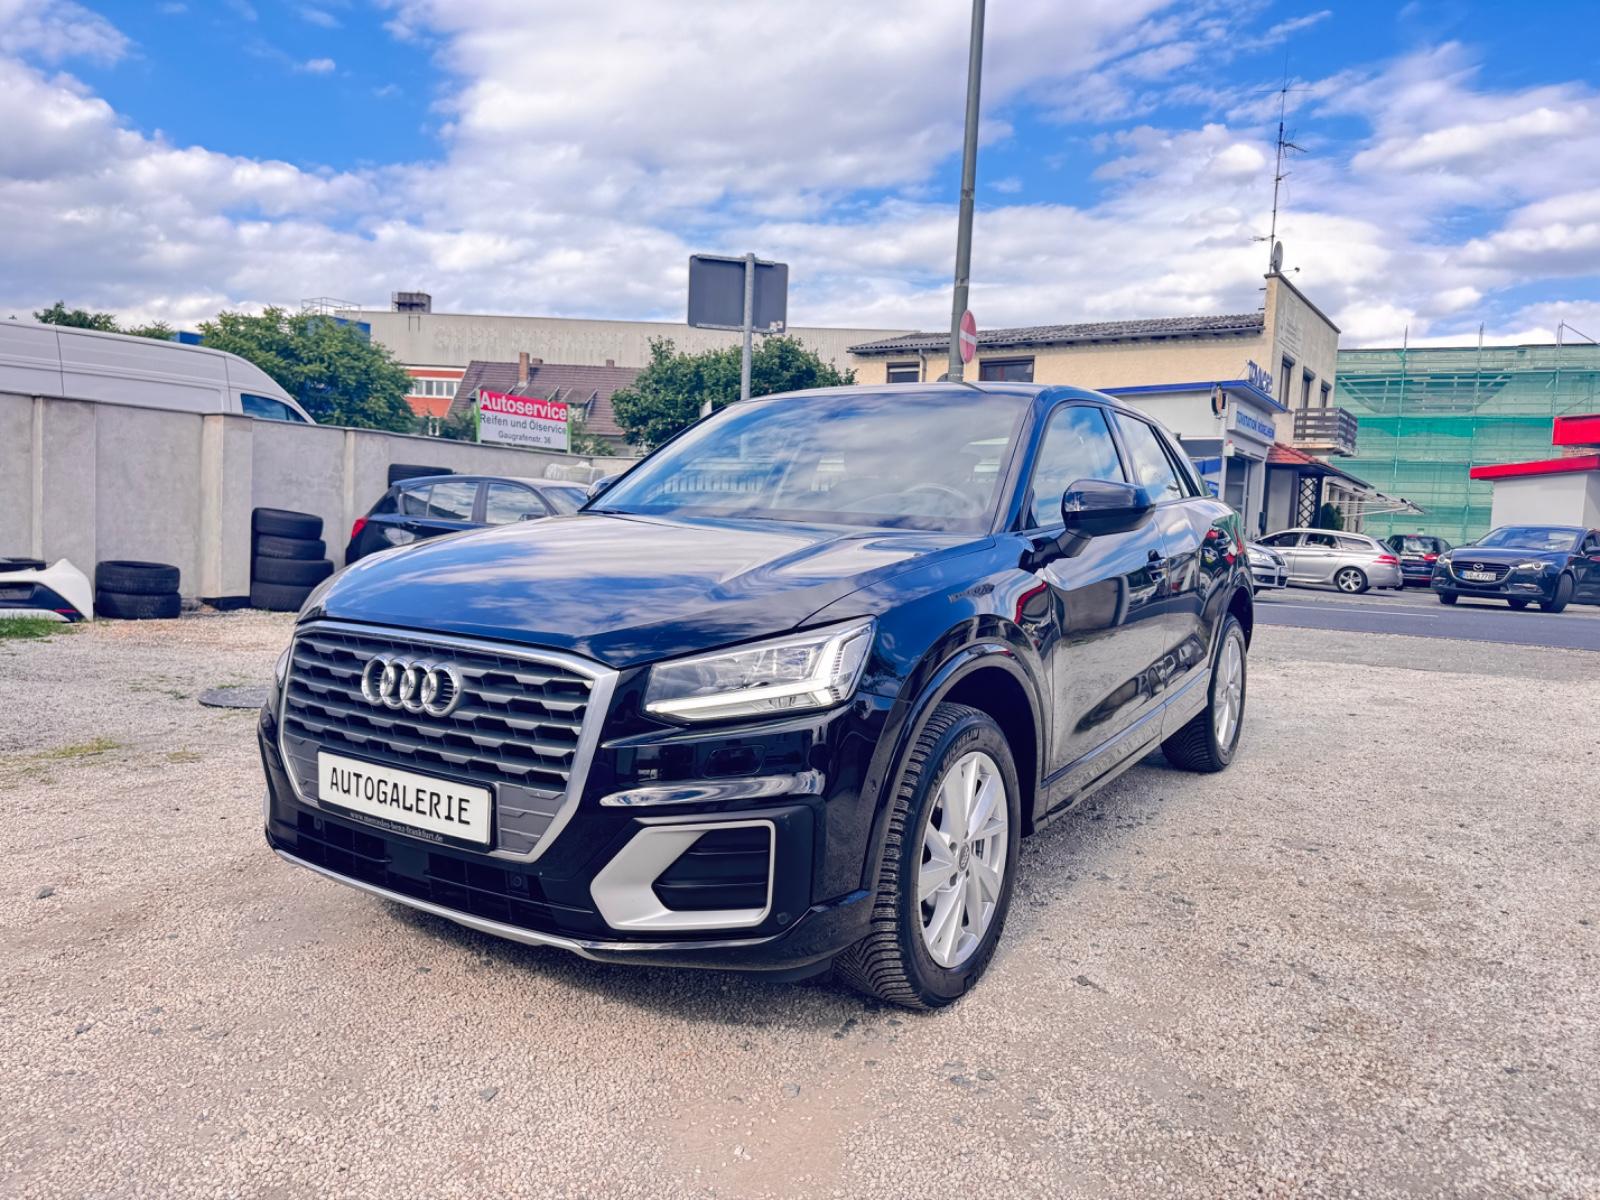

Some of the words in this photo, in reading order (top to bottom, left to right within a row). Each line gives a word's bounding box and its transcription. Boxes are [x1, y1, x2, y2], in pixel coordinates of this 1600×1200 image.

[480, 391, 566, 420] Autoservice
[480, 413, 508, 426] Reifen
[510, 420, 527, 429] und
[498, 430, 542, 443] Gaugrafenstr.
[330, 766, 471, 825] AUTOGALERIE
